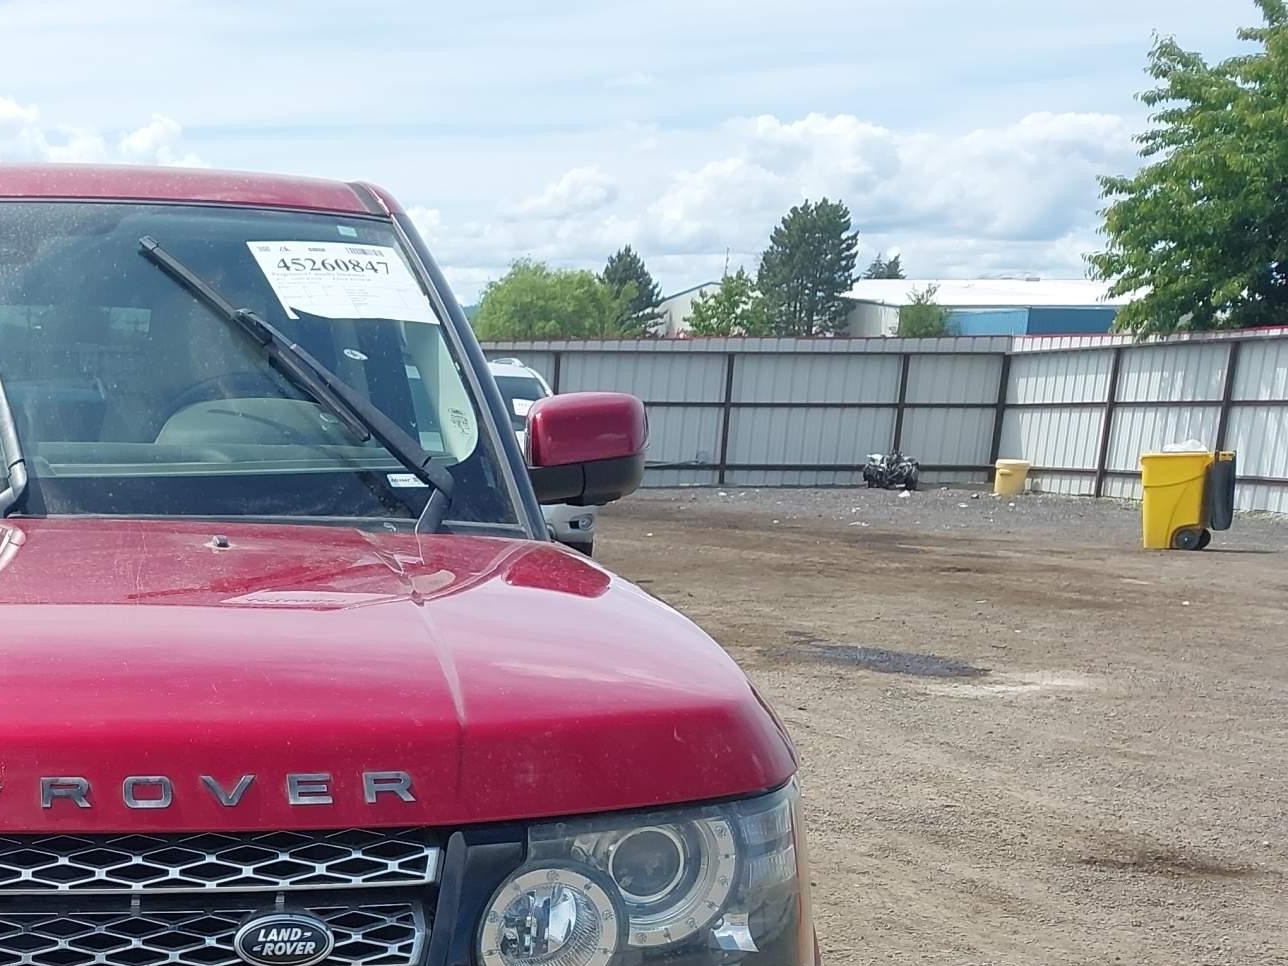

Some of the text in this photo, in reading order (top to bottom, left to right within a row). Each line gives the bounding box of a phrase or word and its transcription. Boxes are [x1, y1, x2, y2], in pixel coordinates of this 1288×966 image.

[277, 257, 390, 275] 45260847
[39, 770, 417, 809] ROVER
[257, 927, 303, 942] LAND
[261, 941, 317, 956] ROVER
